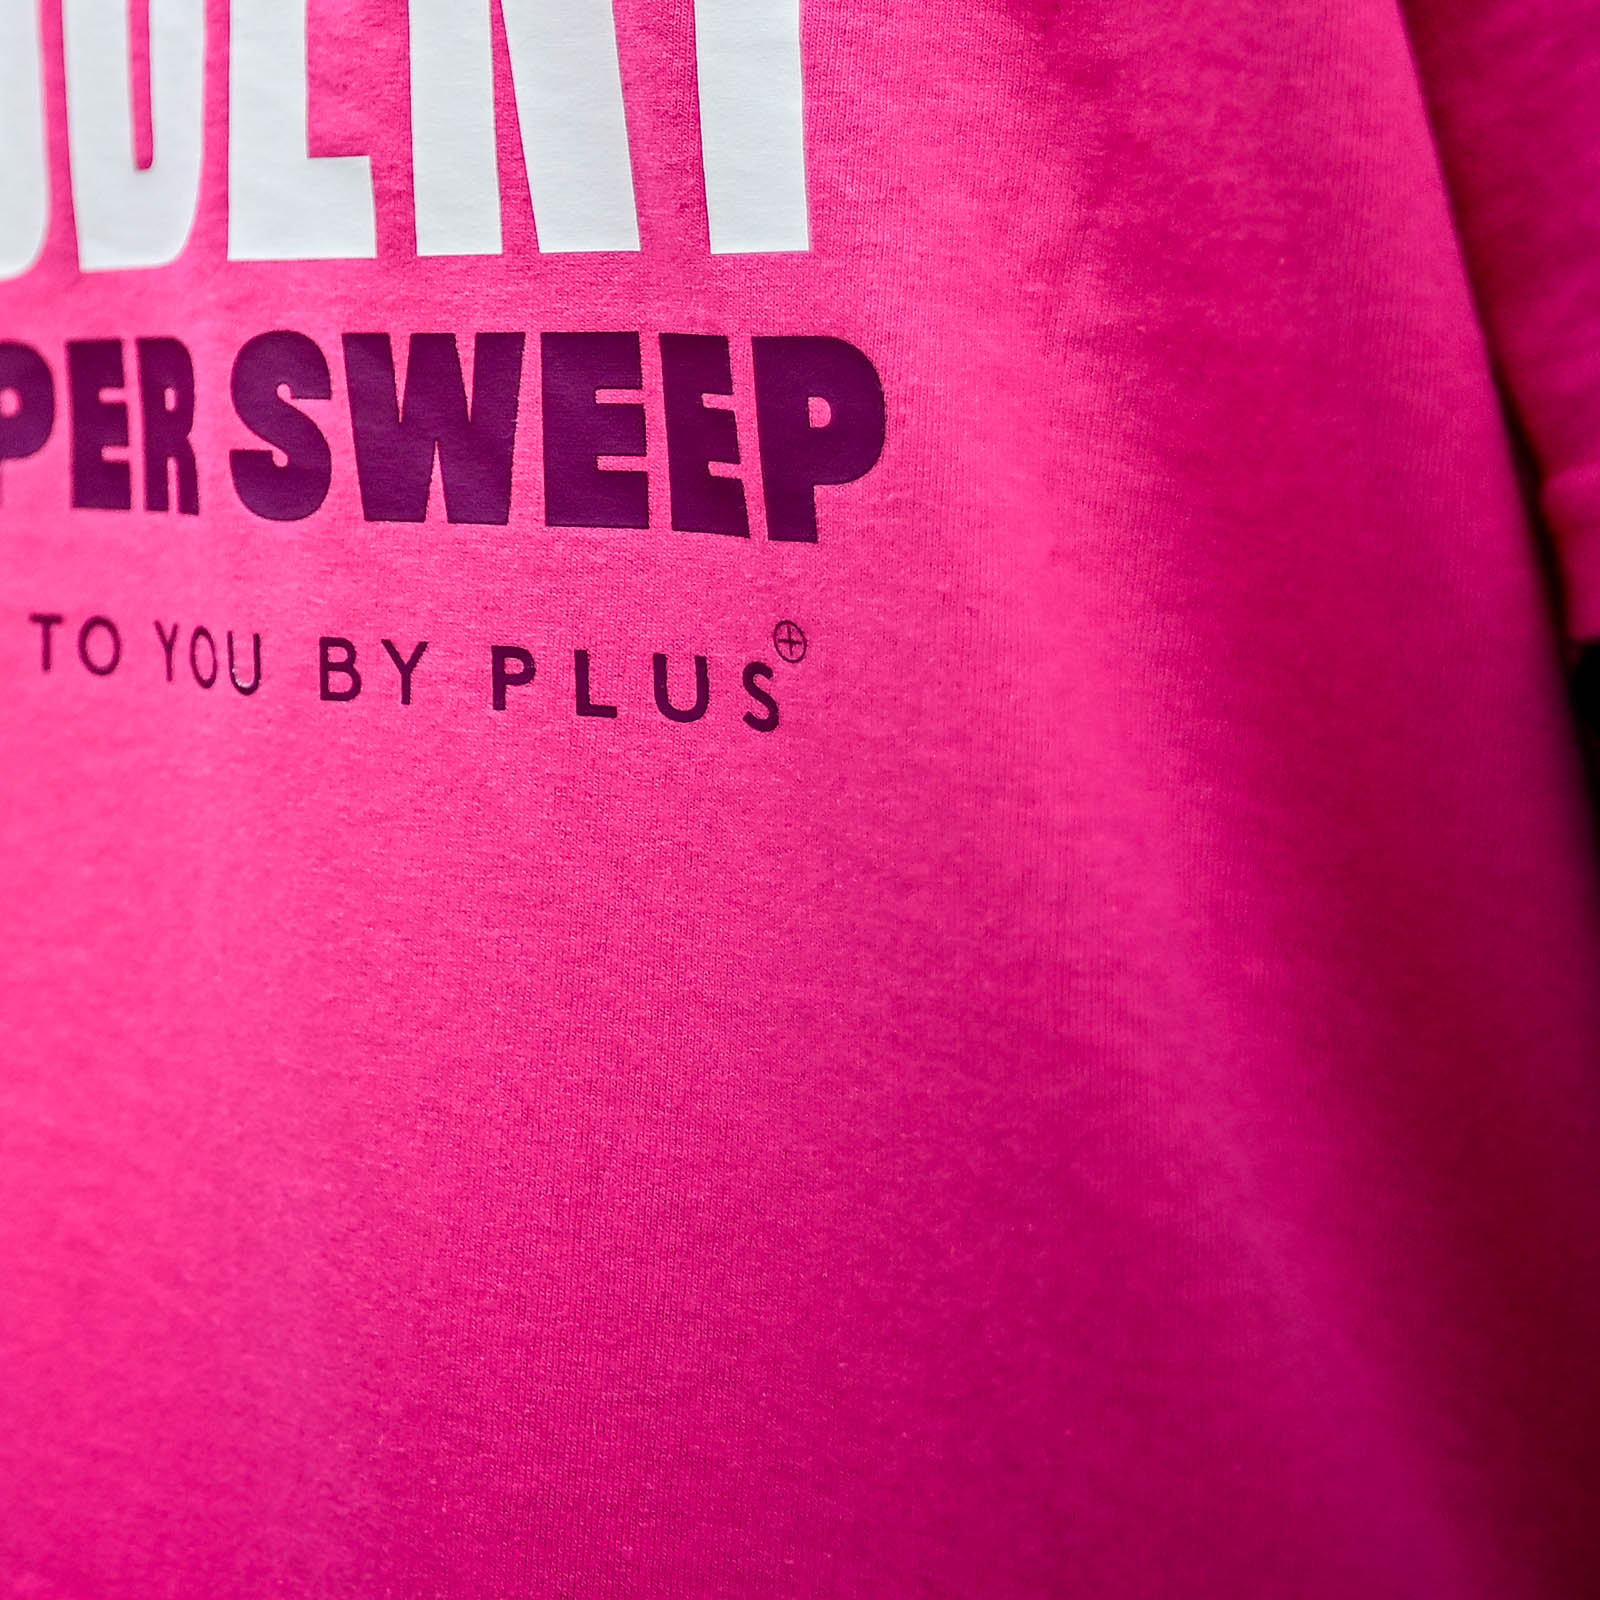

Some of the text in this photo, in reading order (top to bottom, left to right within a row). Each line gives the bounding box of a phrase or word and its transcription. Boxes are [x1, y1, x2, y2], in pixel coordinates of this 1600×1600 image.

[229, 329, 887, 544] SWEEP
[29, 612, 121, 677] TO
[154, 619, 262, 696] YOU
[318, 636, 429, 706] BY
[490, 643, 782, 733] PLUS
